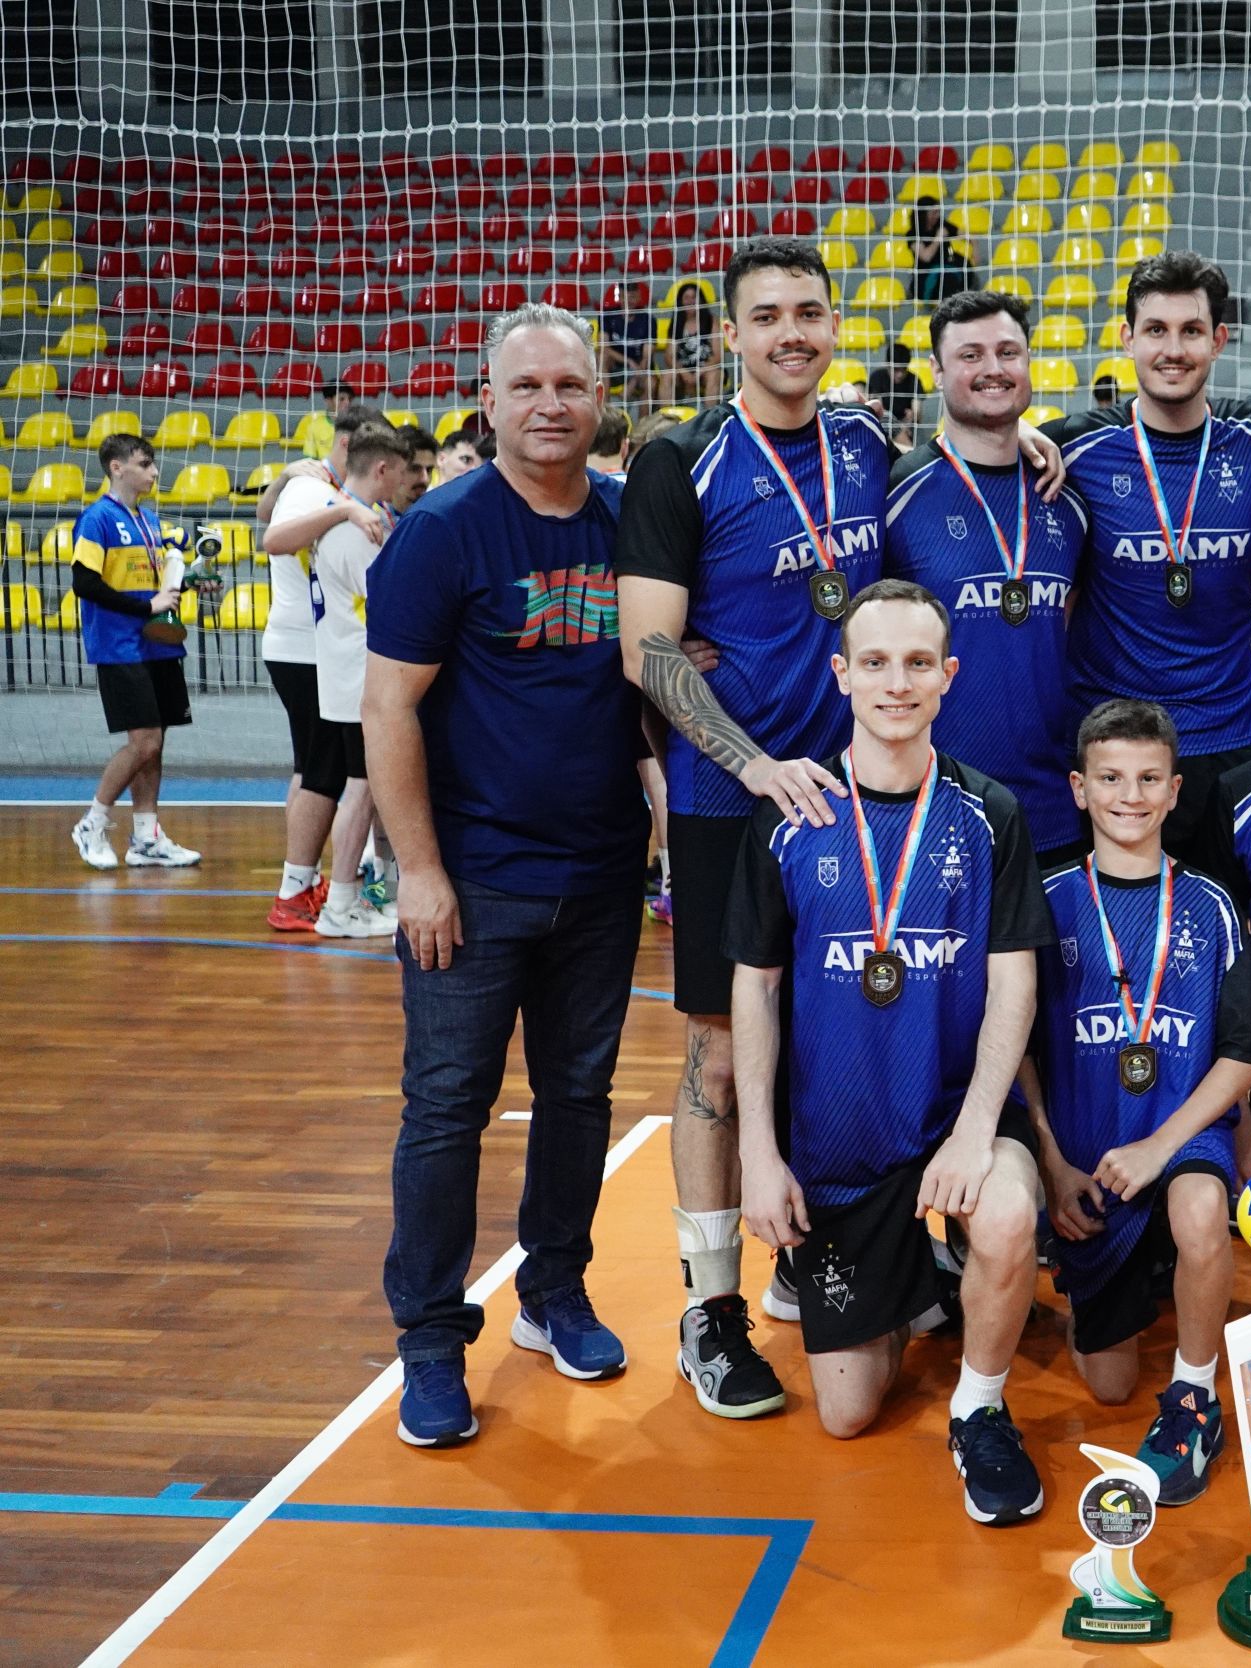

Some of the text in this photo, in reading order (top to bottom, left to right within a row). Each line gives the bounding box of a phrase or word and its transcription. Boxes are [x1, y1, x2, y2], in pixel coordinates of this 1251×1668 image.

[116, 522, 132, 545] 5
[954, 580, 1072, 610] ADMY
[824, 1283, 849, 1295] MÁFIA
[1085, 1620, 1109, 1630] MELHOR
